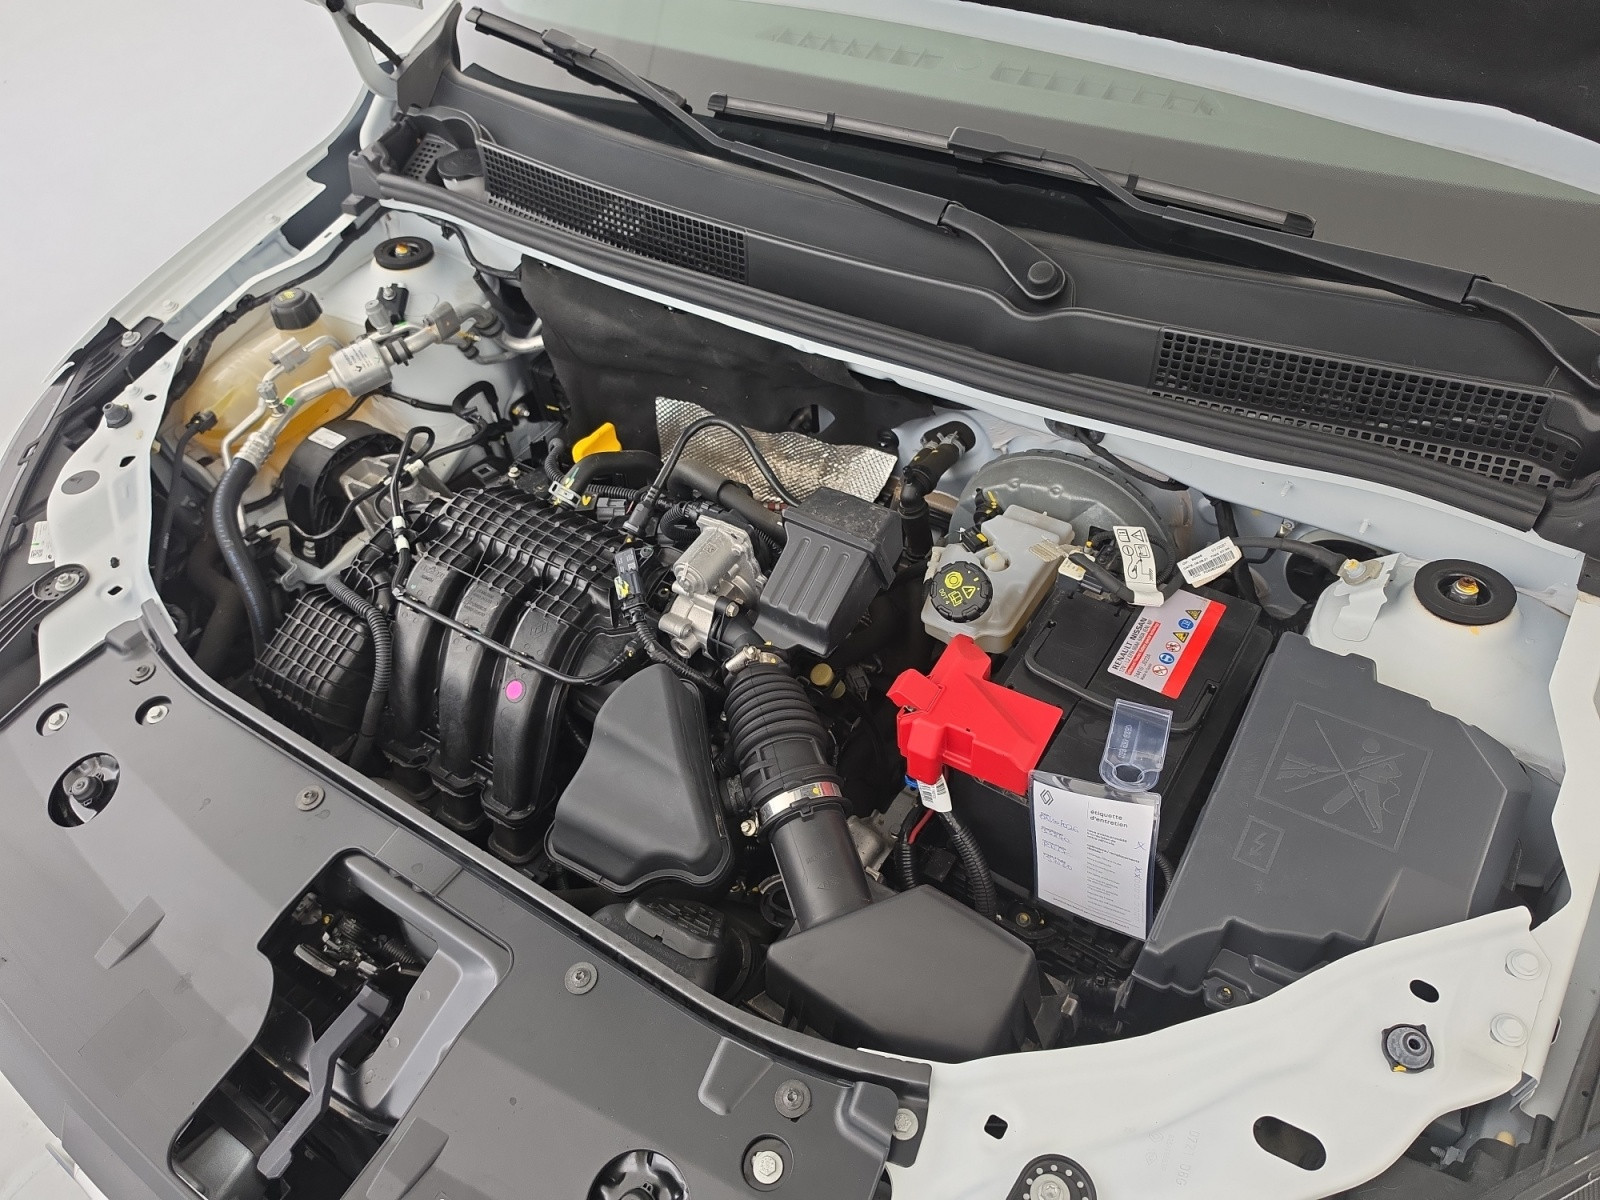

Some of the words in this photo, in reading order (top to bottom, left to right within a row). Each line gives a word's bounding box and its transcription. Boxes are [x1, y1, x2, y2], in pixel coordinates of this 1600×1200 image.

[939, 588, 949, 600] DOT
[1112, 641, 1133, 670] RENAULT
[1130, 617, 1147, 641] NISSAN
[1090, 809, 1123, 820] étiquette
[1089, 816, 1128, 828] d'entretien
